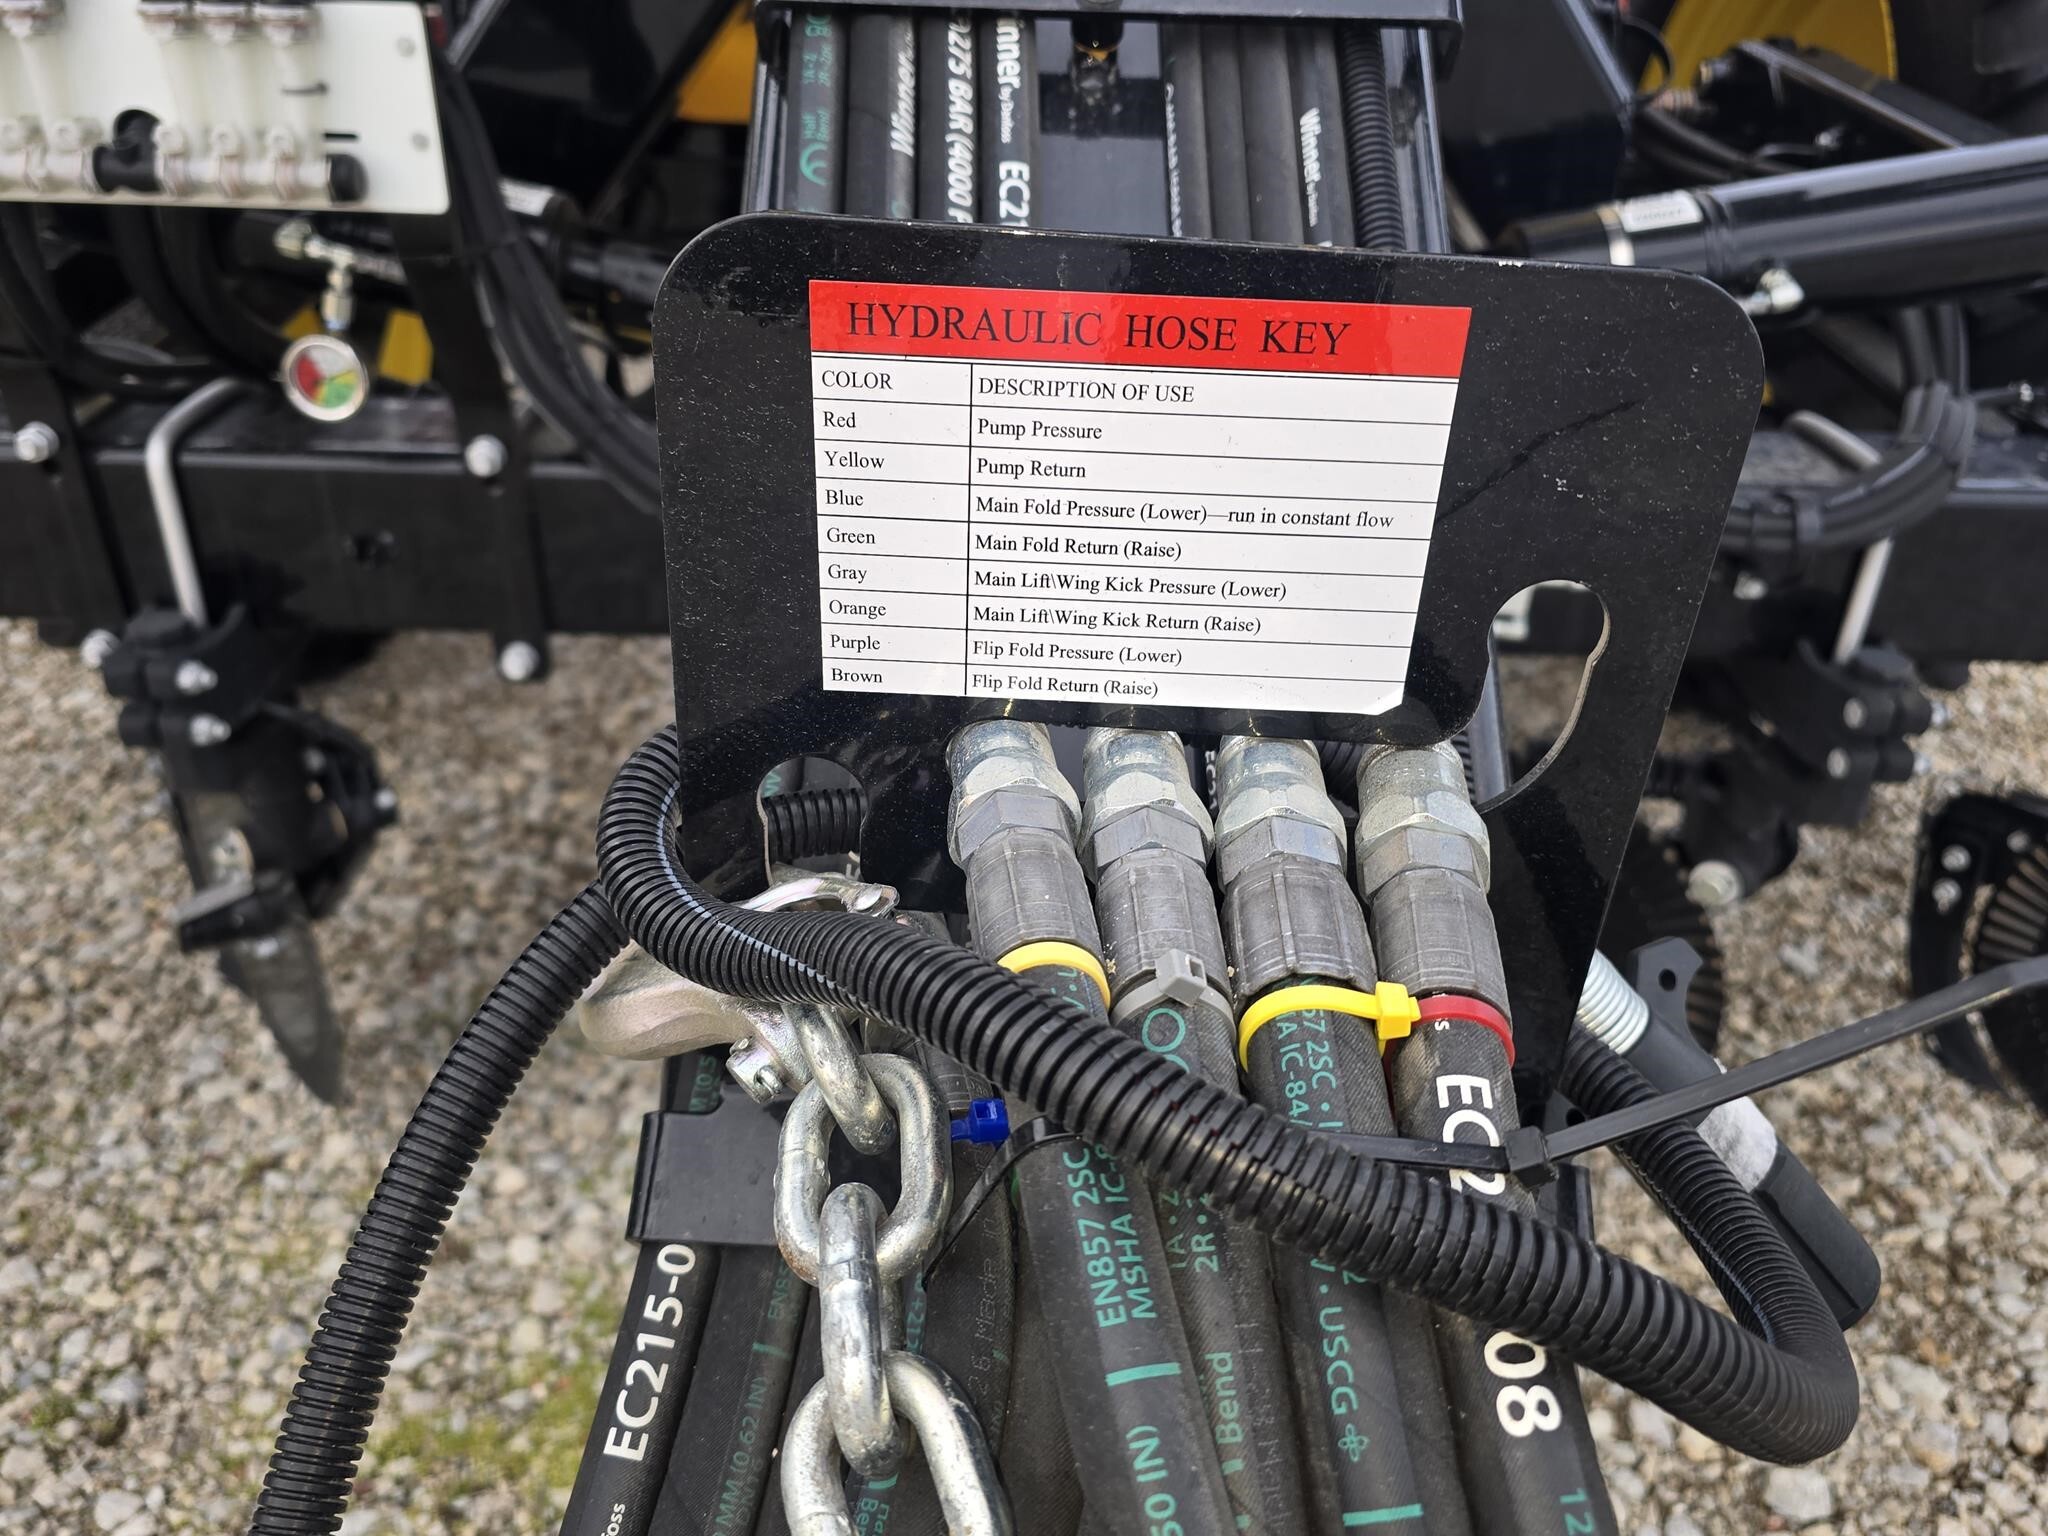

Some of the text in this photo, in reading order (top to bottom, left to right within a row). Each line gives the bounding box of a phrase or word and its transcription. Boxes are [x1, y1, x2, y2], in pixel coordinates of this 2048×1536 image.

[947, 29, 973, 80] 275
[996, 17, 1024, 89] inner
[890, 52, 915, 157] Winner
[948, 78, 974, 134] BAR
[1300, 107, 1321, 183] Winner
[945, 132, 975, 208] (4000
[847, 302, 1352, 355] HYDRAULIC HOSE KEY
[822, 370, 892, 390] COLOR
[979, 378, 1194, 403] DESCRIPTION OF USE
[823, 411, 856, 428] Red
[978, 418, 1102, 441] Pump Pressure
[824, 450, 885, 469] Yellow
[978, 457, 1086, 480] Pump Return
[826, 489, 864, 506] Blue
[976, 496, 1018, 513] Main
[1024, 498, 1061, 515] Fold
[1067, 500, 1135, 519] Pressure
[1261, 507, 1276, 524] in
[1281, 510, 1350, 527] constant
[1355, 511, 1394, 528] flow
[826, 527, 876, 544] Green
[975, 534, 1182, 561] Main Fold Return (Raise)
[827, 563, 867, 584] Gray
[975, 571, 1288, 601] Main Lift\Wing Kick Pressure (Lower)
[829, 599, 886, 620] Orange
[974, 606, 1261, 634] Main Lift\Wing Kick Return (Raise)
[830, 634, 881, 653] Purple
[973, 640, 1182, 665] Flip Fold Pressure (Lower)
[831, 667, 883, 683] Brown
[972, 674, 1159, 698] Flip Fold Return (Raise)
[1275, 1012, 1298, 1041] A
[1306, 1040, 1337, 1090] 2SC
[1062, 1147, 1128, 1328] EN857 2SC
[1110, 1213, 1159, 1319] MSHA
[974, 1257, 1000, 1343] Made
[1318, 1306, 1360, 1416] USCG
[1204, 1351, 1245, 1444] Bend
[1484, 1331, 1562, 1437] 08
[1126, 1425, 1169, 1483] IN)
